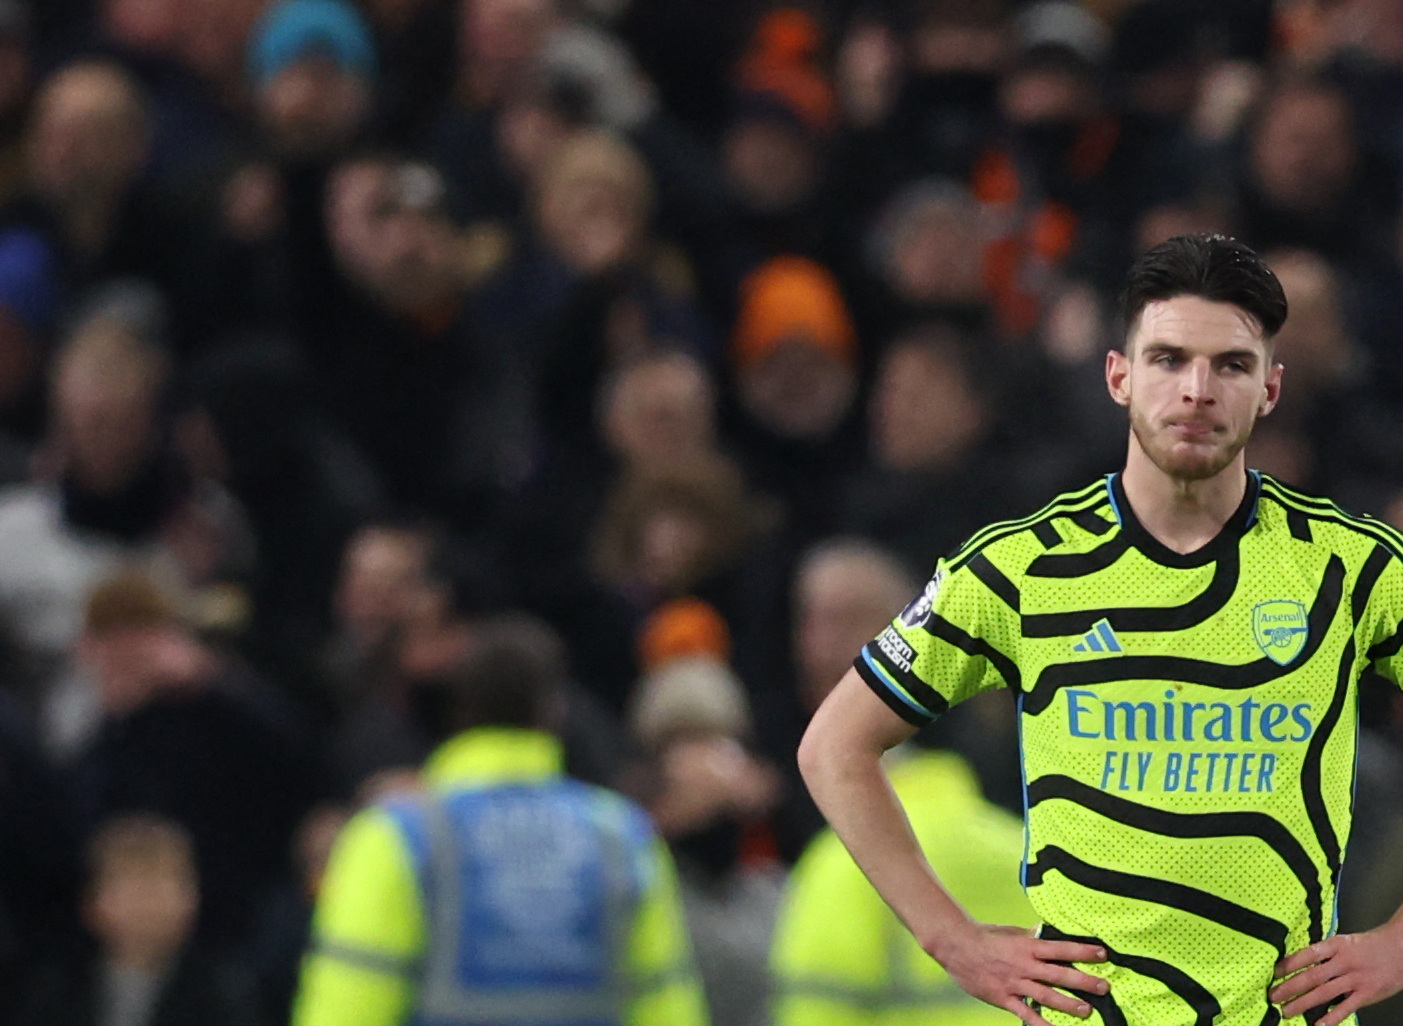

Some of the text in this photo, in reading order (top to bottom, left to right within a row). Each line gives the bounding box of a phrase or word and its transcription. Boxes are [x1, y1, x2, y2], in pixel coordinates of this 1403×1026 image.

[1261, 613, 1300, 622] Arsenal
[885, 627, 913, 660] room
[1065, 689, 1313, 742] Emirates
[1100, 751, 1277, 793] FLY BETTER
